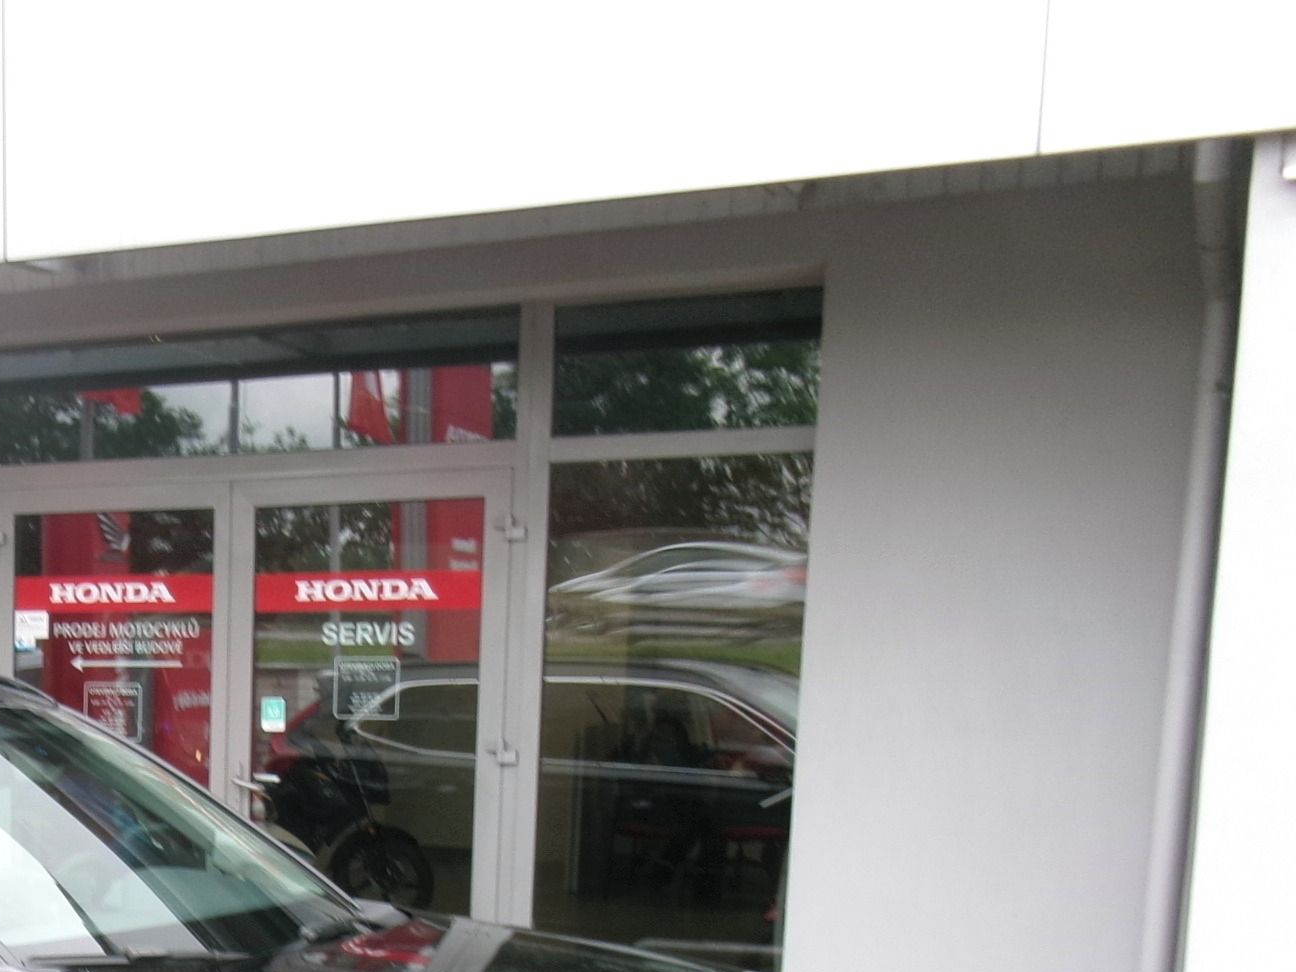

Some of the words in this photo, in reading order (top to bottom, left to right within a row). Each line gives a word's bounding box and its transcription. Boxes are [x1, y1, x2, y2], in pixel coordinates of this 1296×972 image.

[49, 582, 176, 604] HONDA
[295, 578, 439, 602] HONDA
[53, 622, 106, 639] PRODEJ
[109, 617, 200, 639] MOTOCYKLŮ
[321, 621, 415, 646] SERVIS
[67, 640, 84, 655] VE
